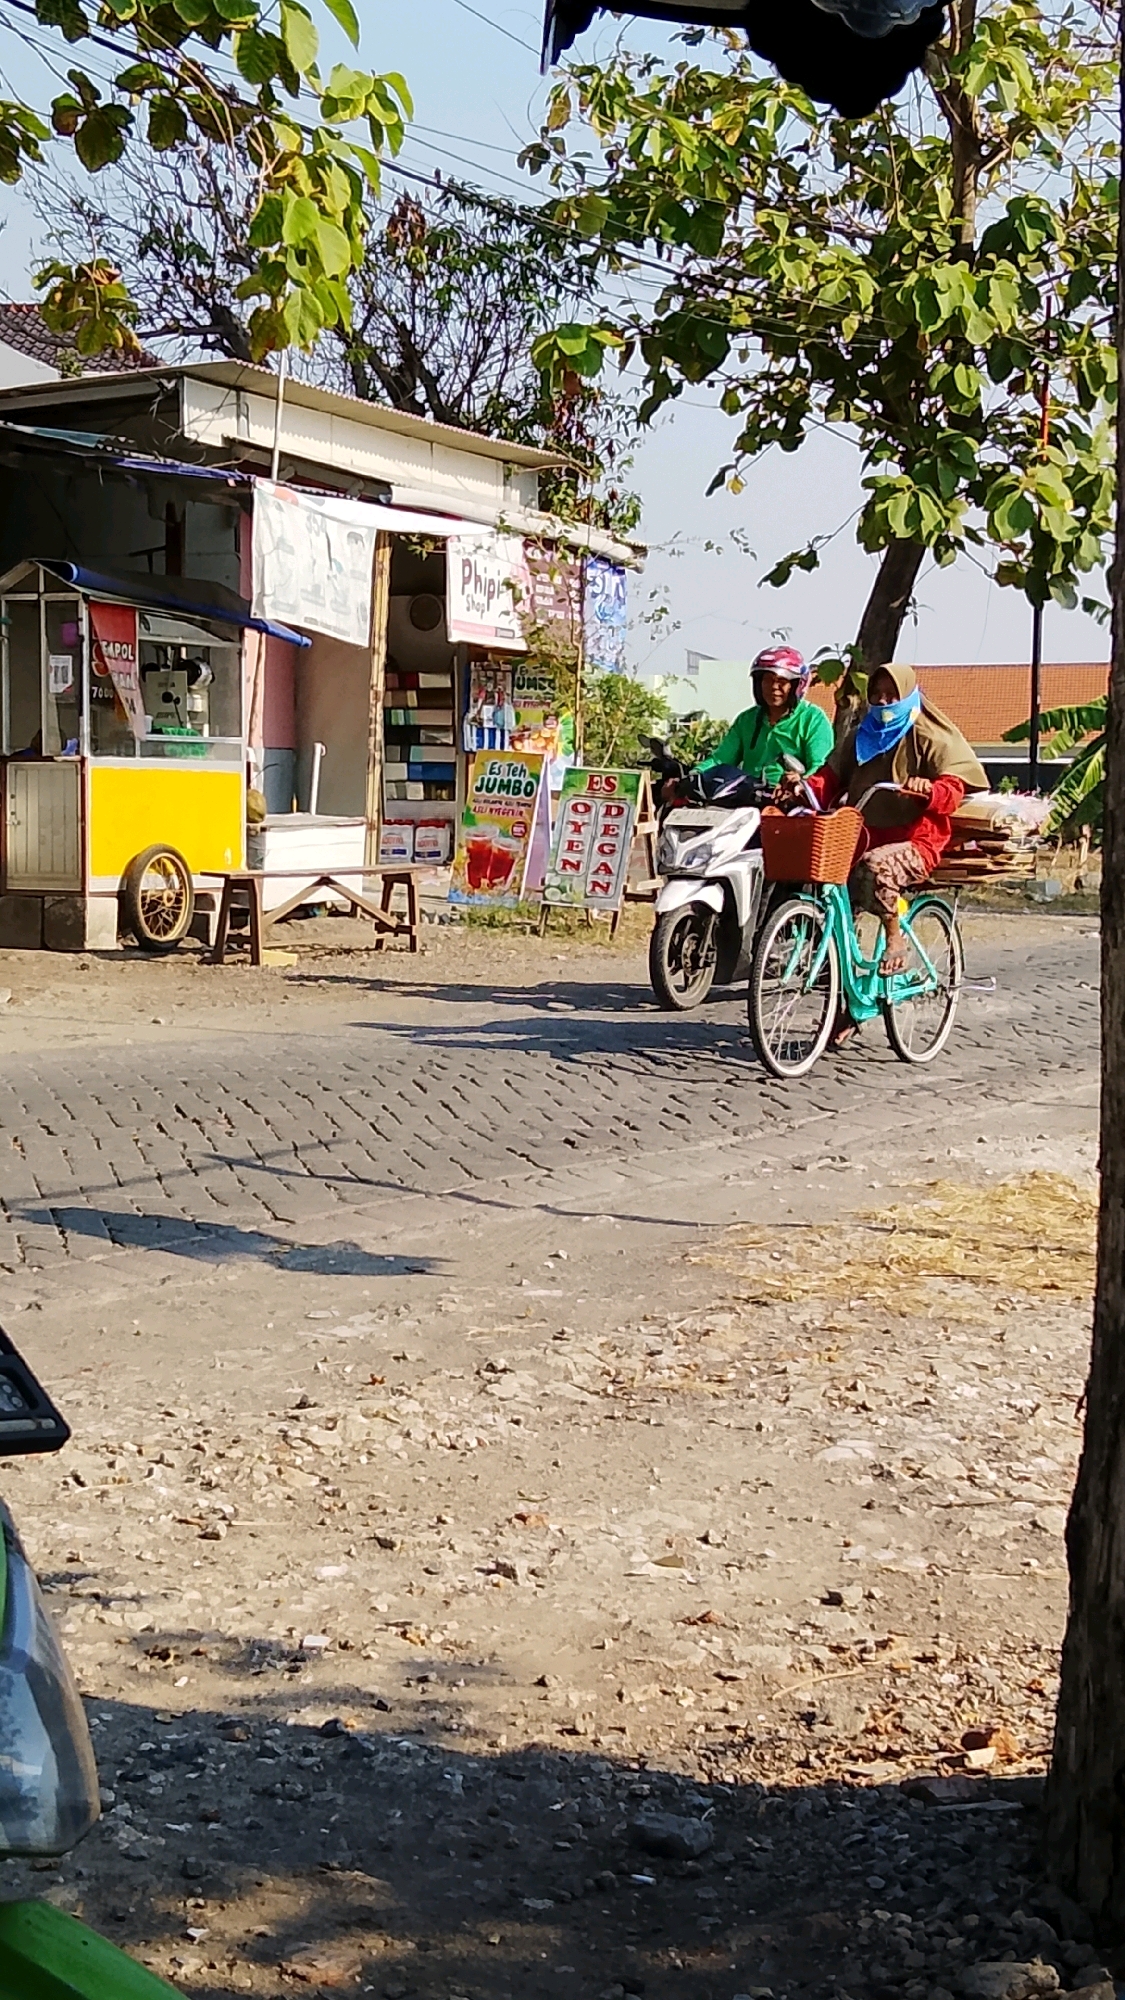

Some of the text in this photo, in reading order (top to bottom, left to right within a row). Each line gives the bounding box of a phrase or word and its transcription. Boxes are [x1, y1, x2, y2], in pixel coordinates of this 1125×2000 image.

[461, 557, 500, 612] Phipi
[466, 592, 486, 620] Shop
[488, 761, 527, 778] Es Teh
[586, 774, 617, 793] ES
[474, 776, 535, 797] JUMBO
[560, 801, 592, 873] OYEN
[590, 804, 625, 895] DEGAN
